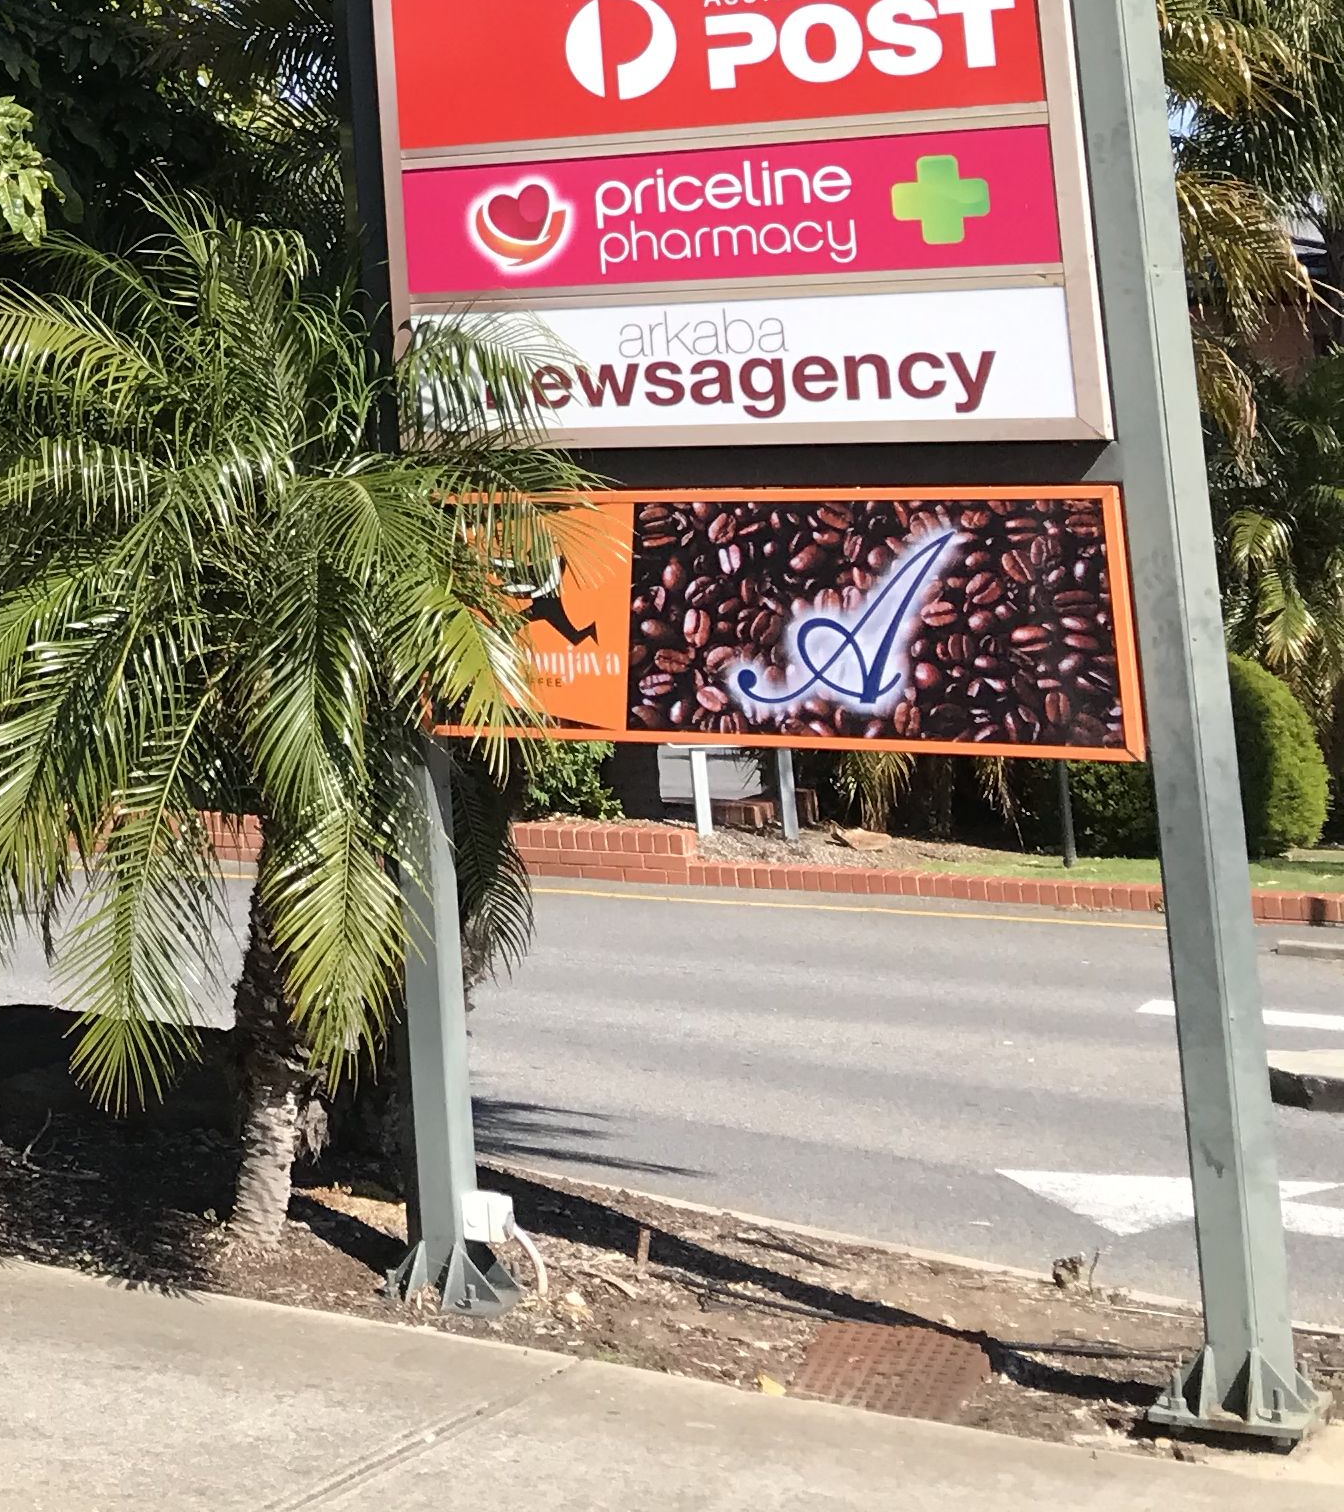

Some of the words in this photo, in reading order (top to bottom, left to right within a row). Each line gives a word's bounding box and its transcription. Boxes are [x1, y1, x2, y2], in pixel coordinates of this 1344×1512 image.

[595, 160, 853, 228] priceline
[599, 217, 857, 276] pharmacy
[617, 307, 790, 359] arkaba
